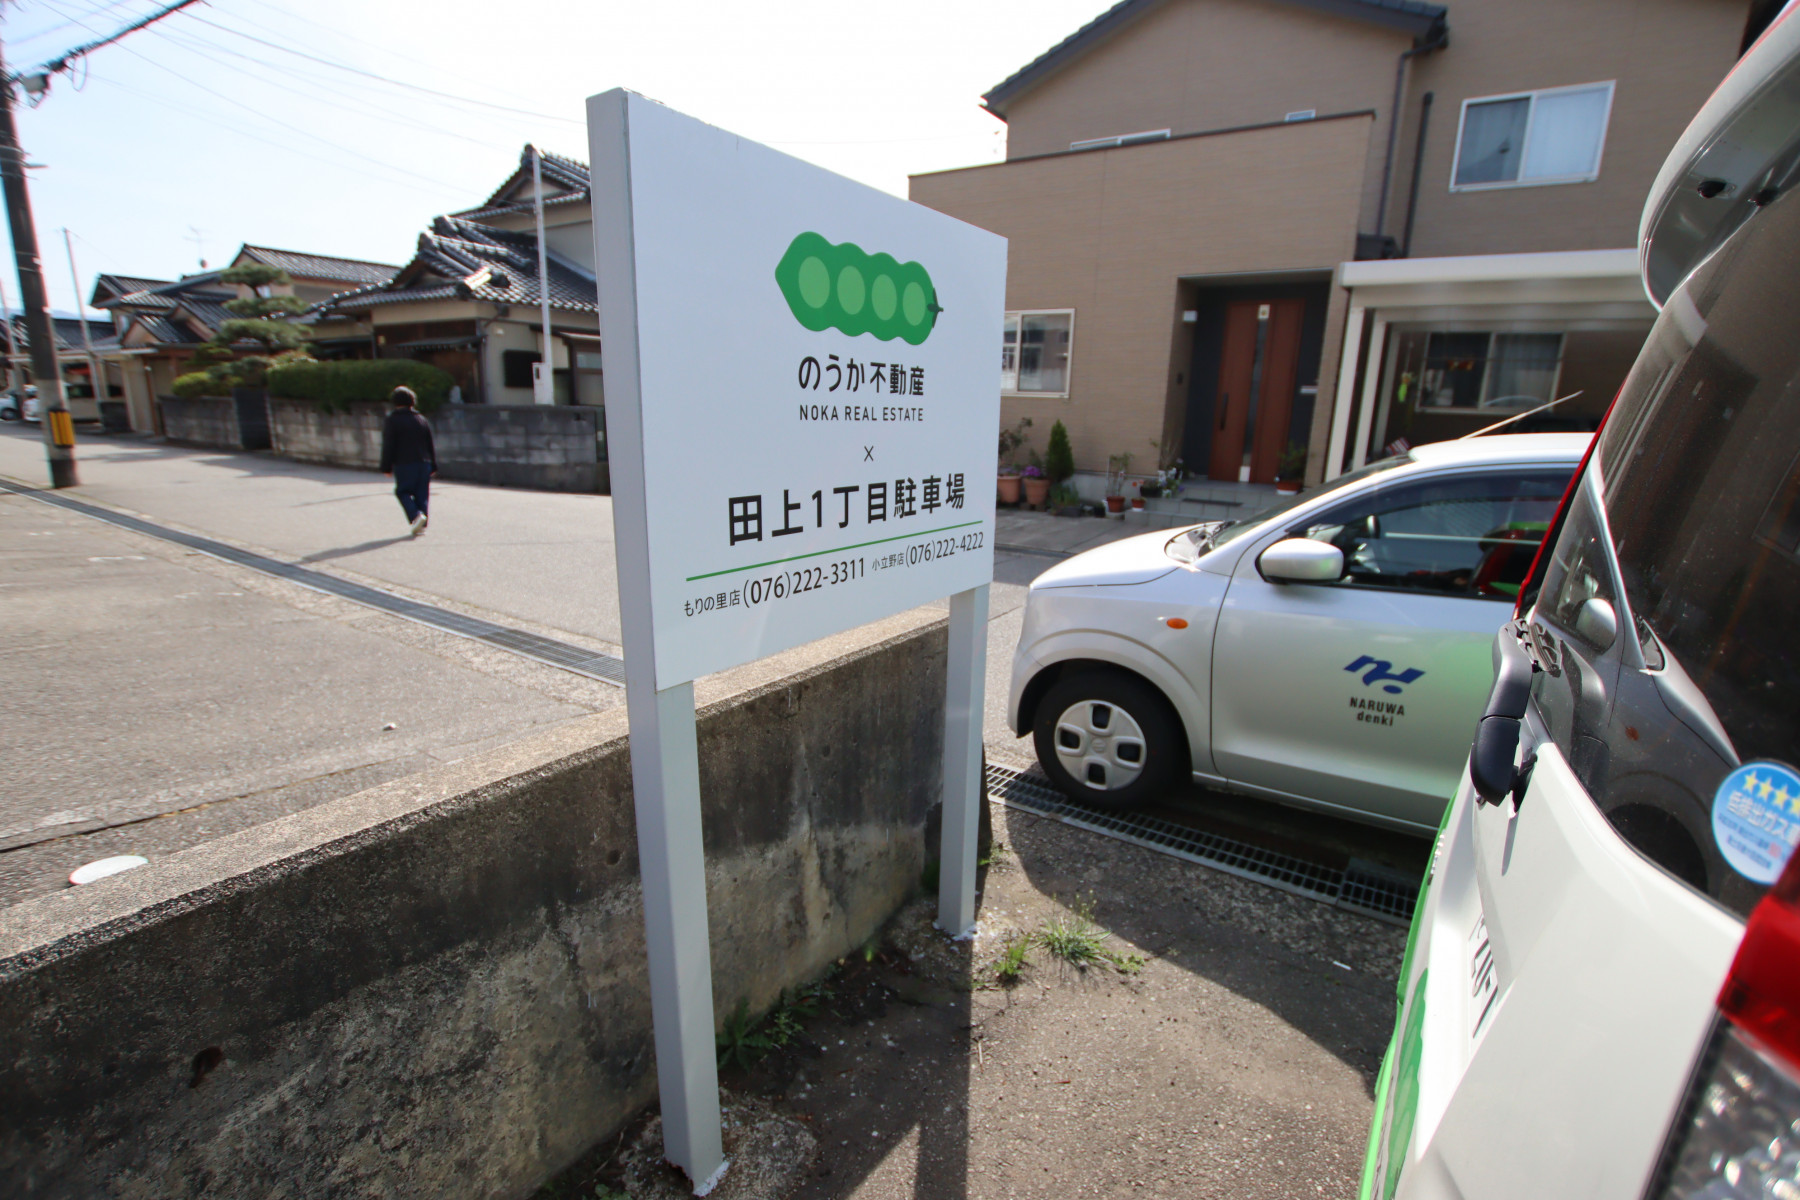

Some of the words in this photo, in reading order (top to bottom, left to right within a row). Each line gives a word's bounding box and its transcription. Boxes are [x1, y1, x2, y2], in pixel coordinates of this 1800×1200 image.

[798, 353, 925, 396] のうか不動産
[799, 404, 839, 421] NOKA
[844, 405, 878, 421] REAL
[882, 406, 924, 421] ESTATE
[728, 473, 965, 546] 田上1丁目駐車場
[1349, 696, 1405, 716] NARUWA
[1356, 711, 1394, 727] denki
